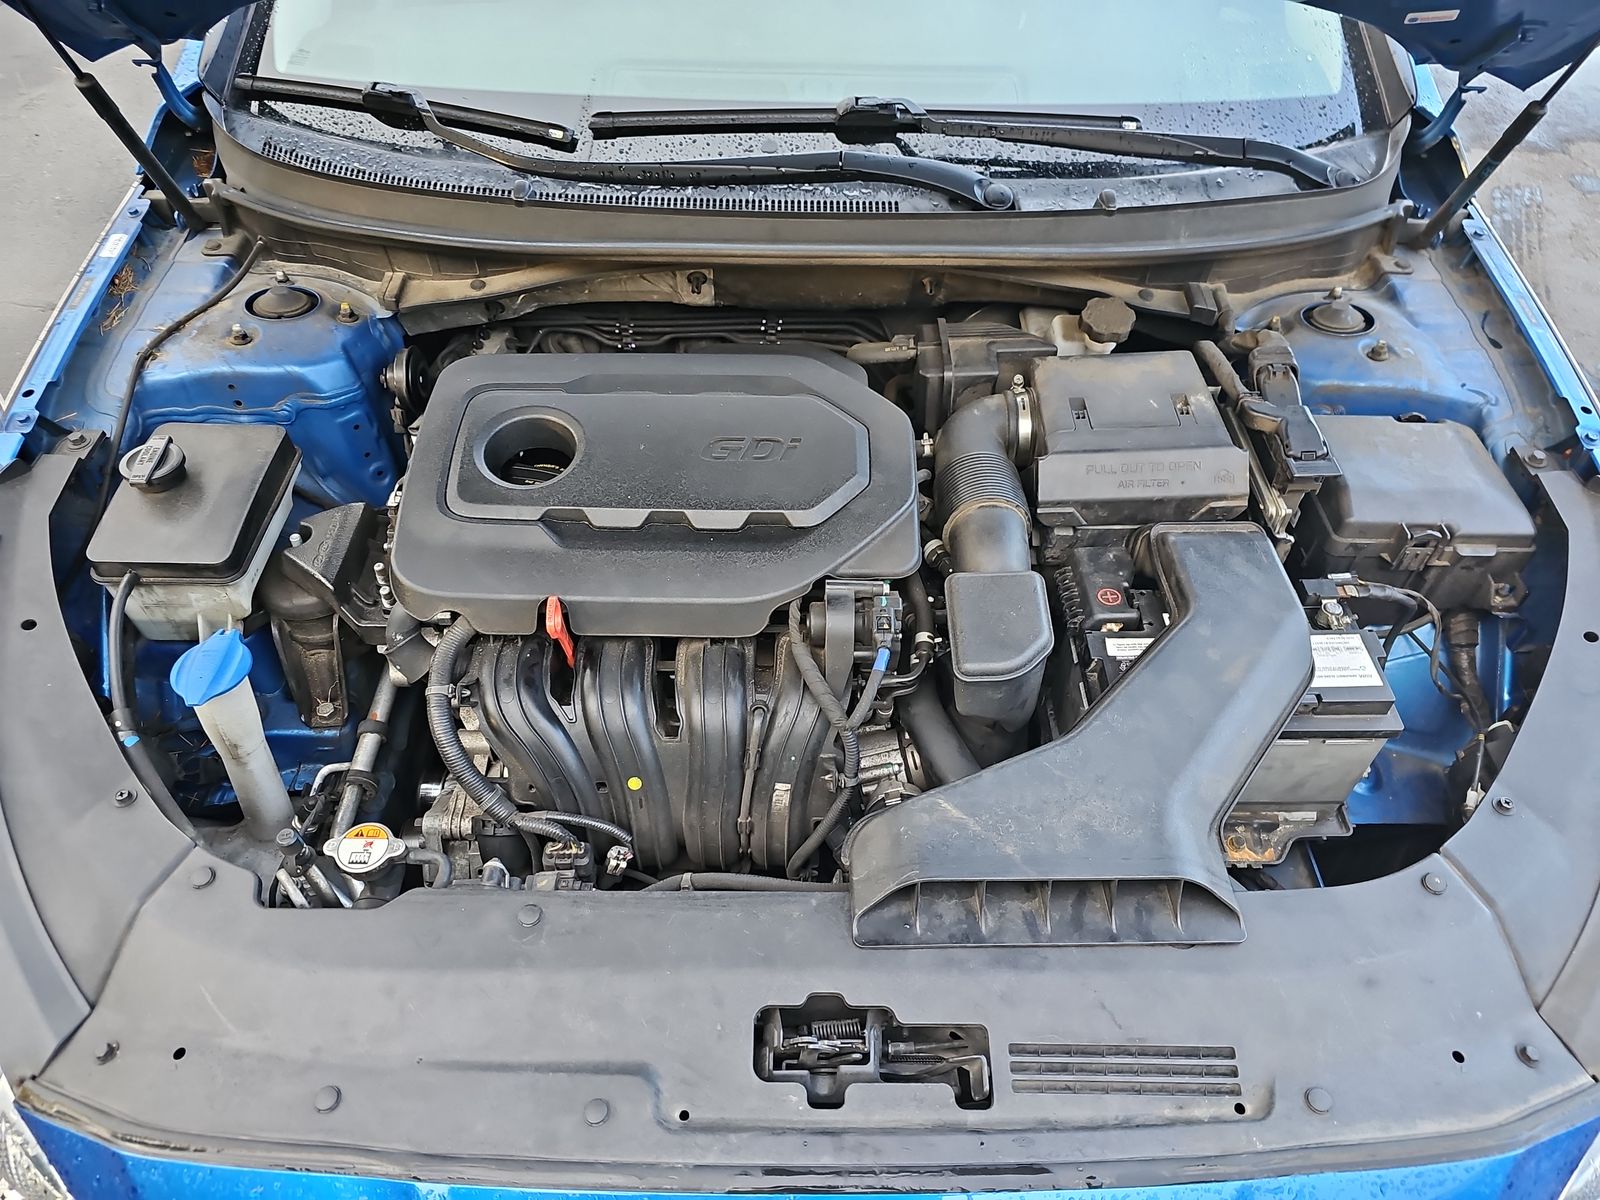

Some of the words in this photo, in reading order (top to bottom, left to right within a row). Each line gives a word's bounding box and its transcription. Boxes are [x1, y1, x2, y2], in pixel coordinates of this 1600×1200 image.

[136, 445, 154, 465] COOLANT
[145, 447, 161, 464] ENGINE
[1086, 464, 1117, 475] PULL
[1120, 463, 1144, 473] OUT
[1150, 462, 1165, 472] TO
[1169, 461, 1202, 472] OPEN
[1117, 479, 1134, 489] AIR
[1136, 479, 1170, 488] FILTER
